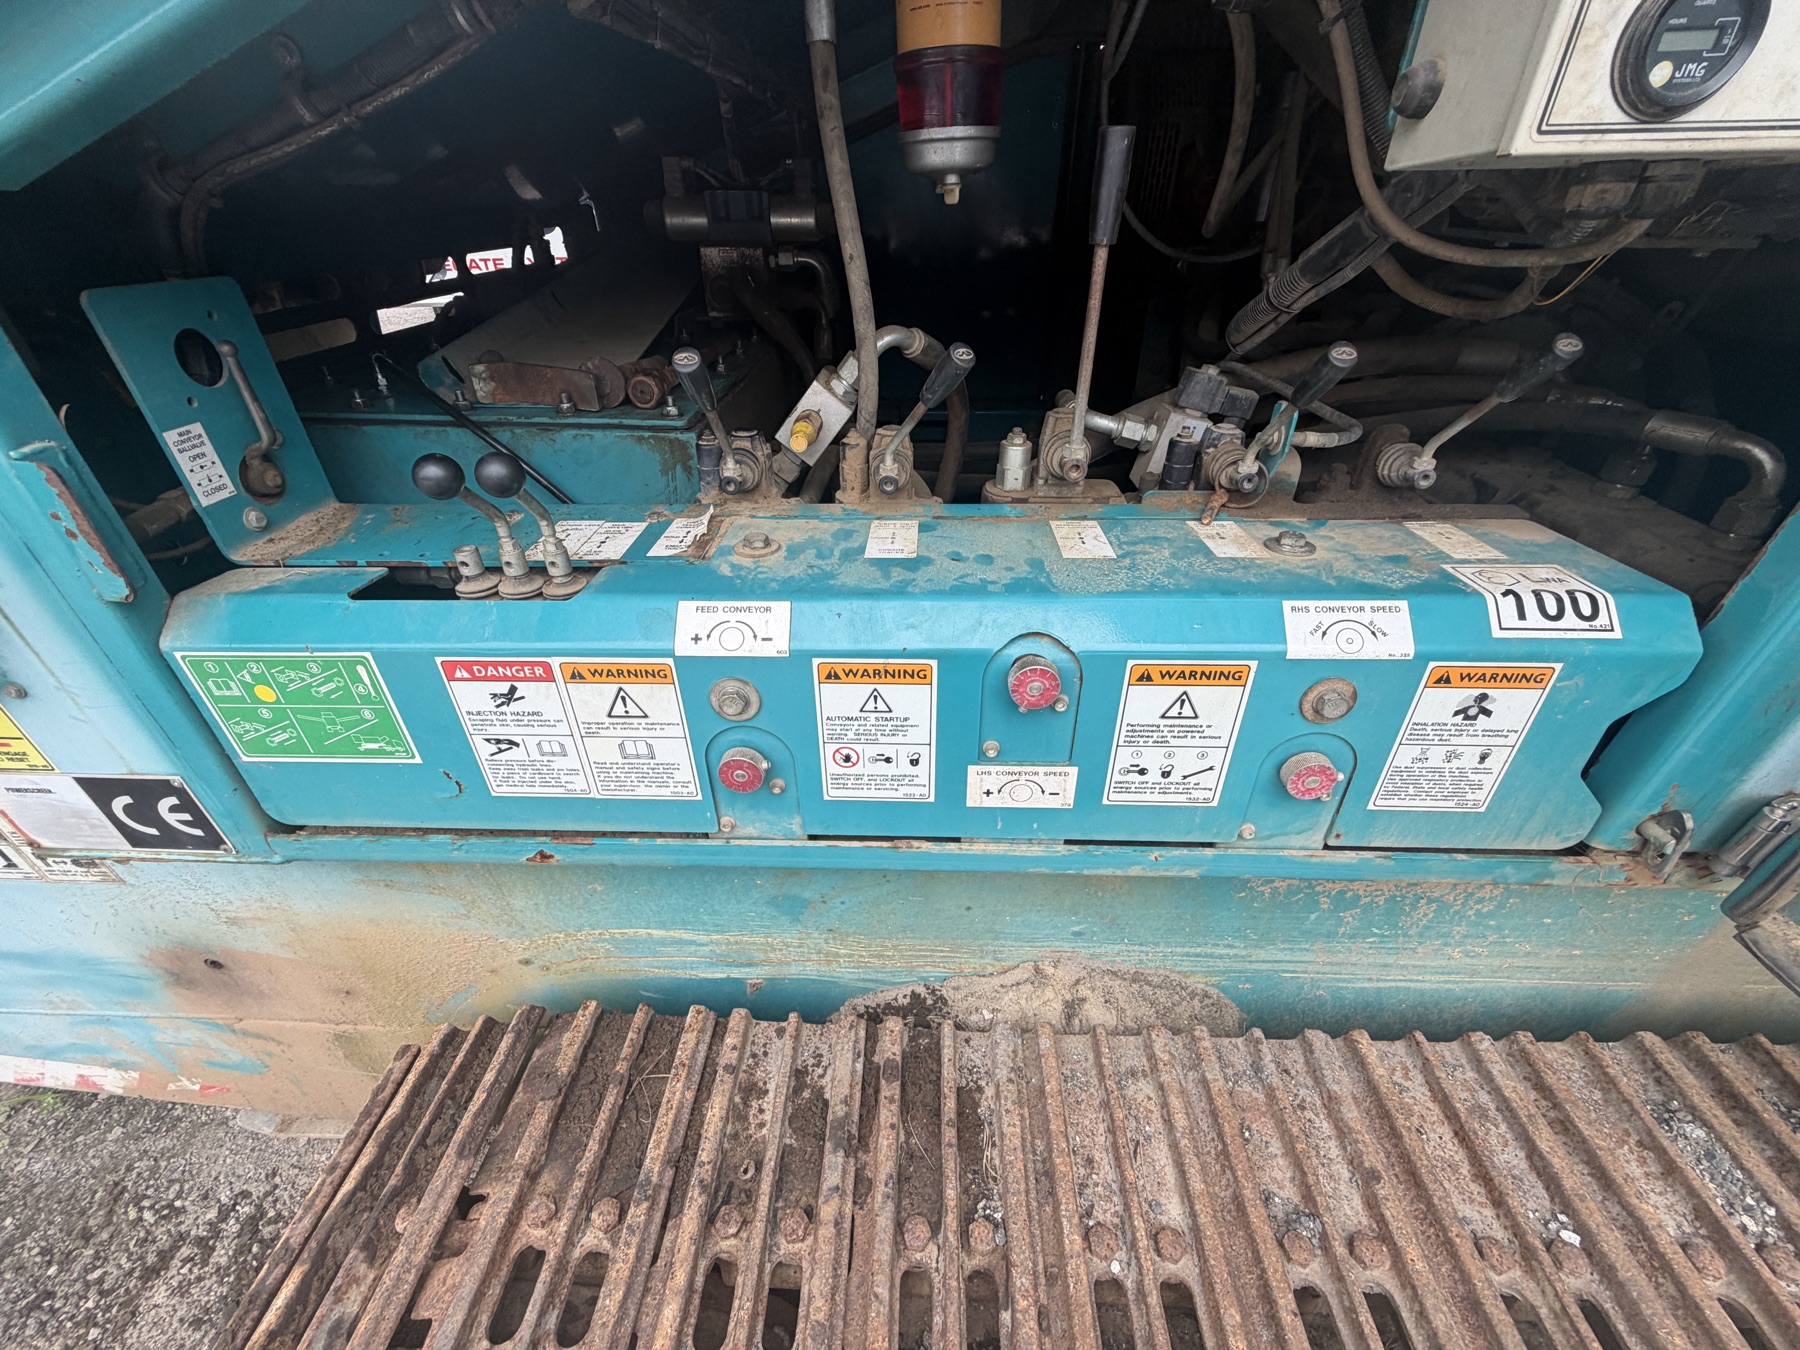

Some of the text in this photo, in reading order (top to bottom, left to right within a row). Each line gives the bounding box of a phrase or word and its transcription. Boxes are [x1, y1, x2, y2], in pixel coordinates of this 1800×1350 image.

[1675, 62, 1709, 77] JMG
[173, 433, 203, 447] CONVEYOR
[177, 429, 192, 437] MAIN
[177, 440, 206, 454] BALLVALVE
[188, 451, 207, 462] OPEN
[202, 483, 228, 497] CLOSED
[1500, 589, 1600, 622] 100
[1310, 621, 1324, 636] FAST
[1368, 620, 1389, 638] SLOW
[472, 666, 546, 677] DANGER
[587, 669, 667, 678] WARNING
[842, 669, 927, 679] WARNING
[1159, 670, 1244, 681] WARNING
[1459, 672, 1547, 683] WARNING
[111, 795, 205, 836] CE
